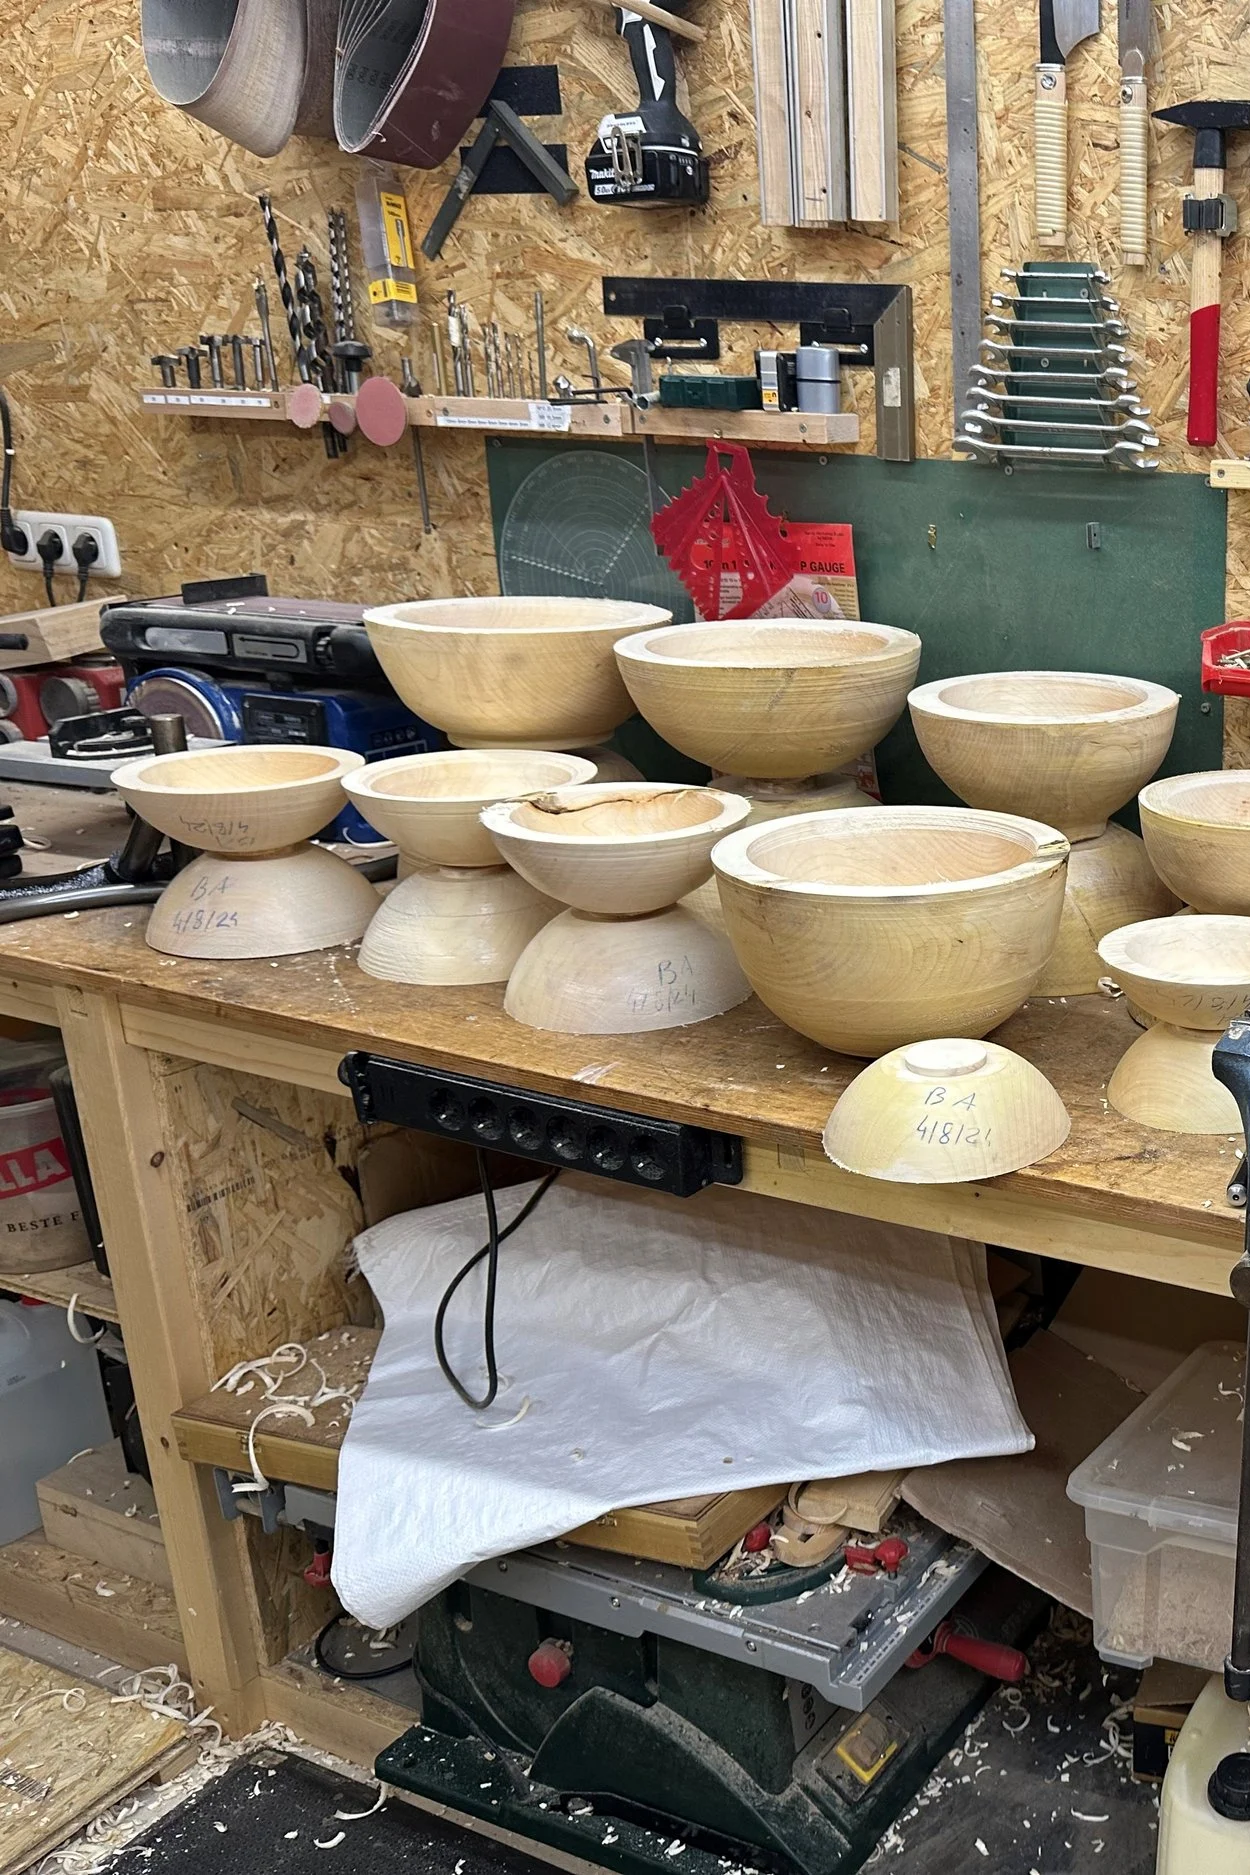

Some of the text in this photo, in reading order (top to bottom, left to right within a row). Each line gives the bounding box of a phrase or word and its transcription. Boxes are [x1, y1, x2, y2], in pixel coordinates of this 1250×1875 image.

[810, 562, 846, 573] GAUGE
[815, 592, 828, 605] 10
[190, 876, 209, 901] B
[658, 960, 677, 986] B
[924, 1086, 977, 1111] B A
[6, 1215, 63, 1233] BESTE
